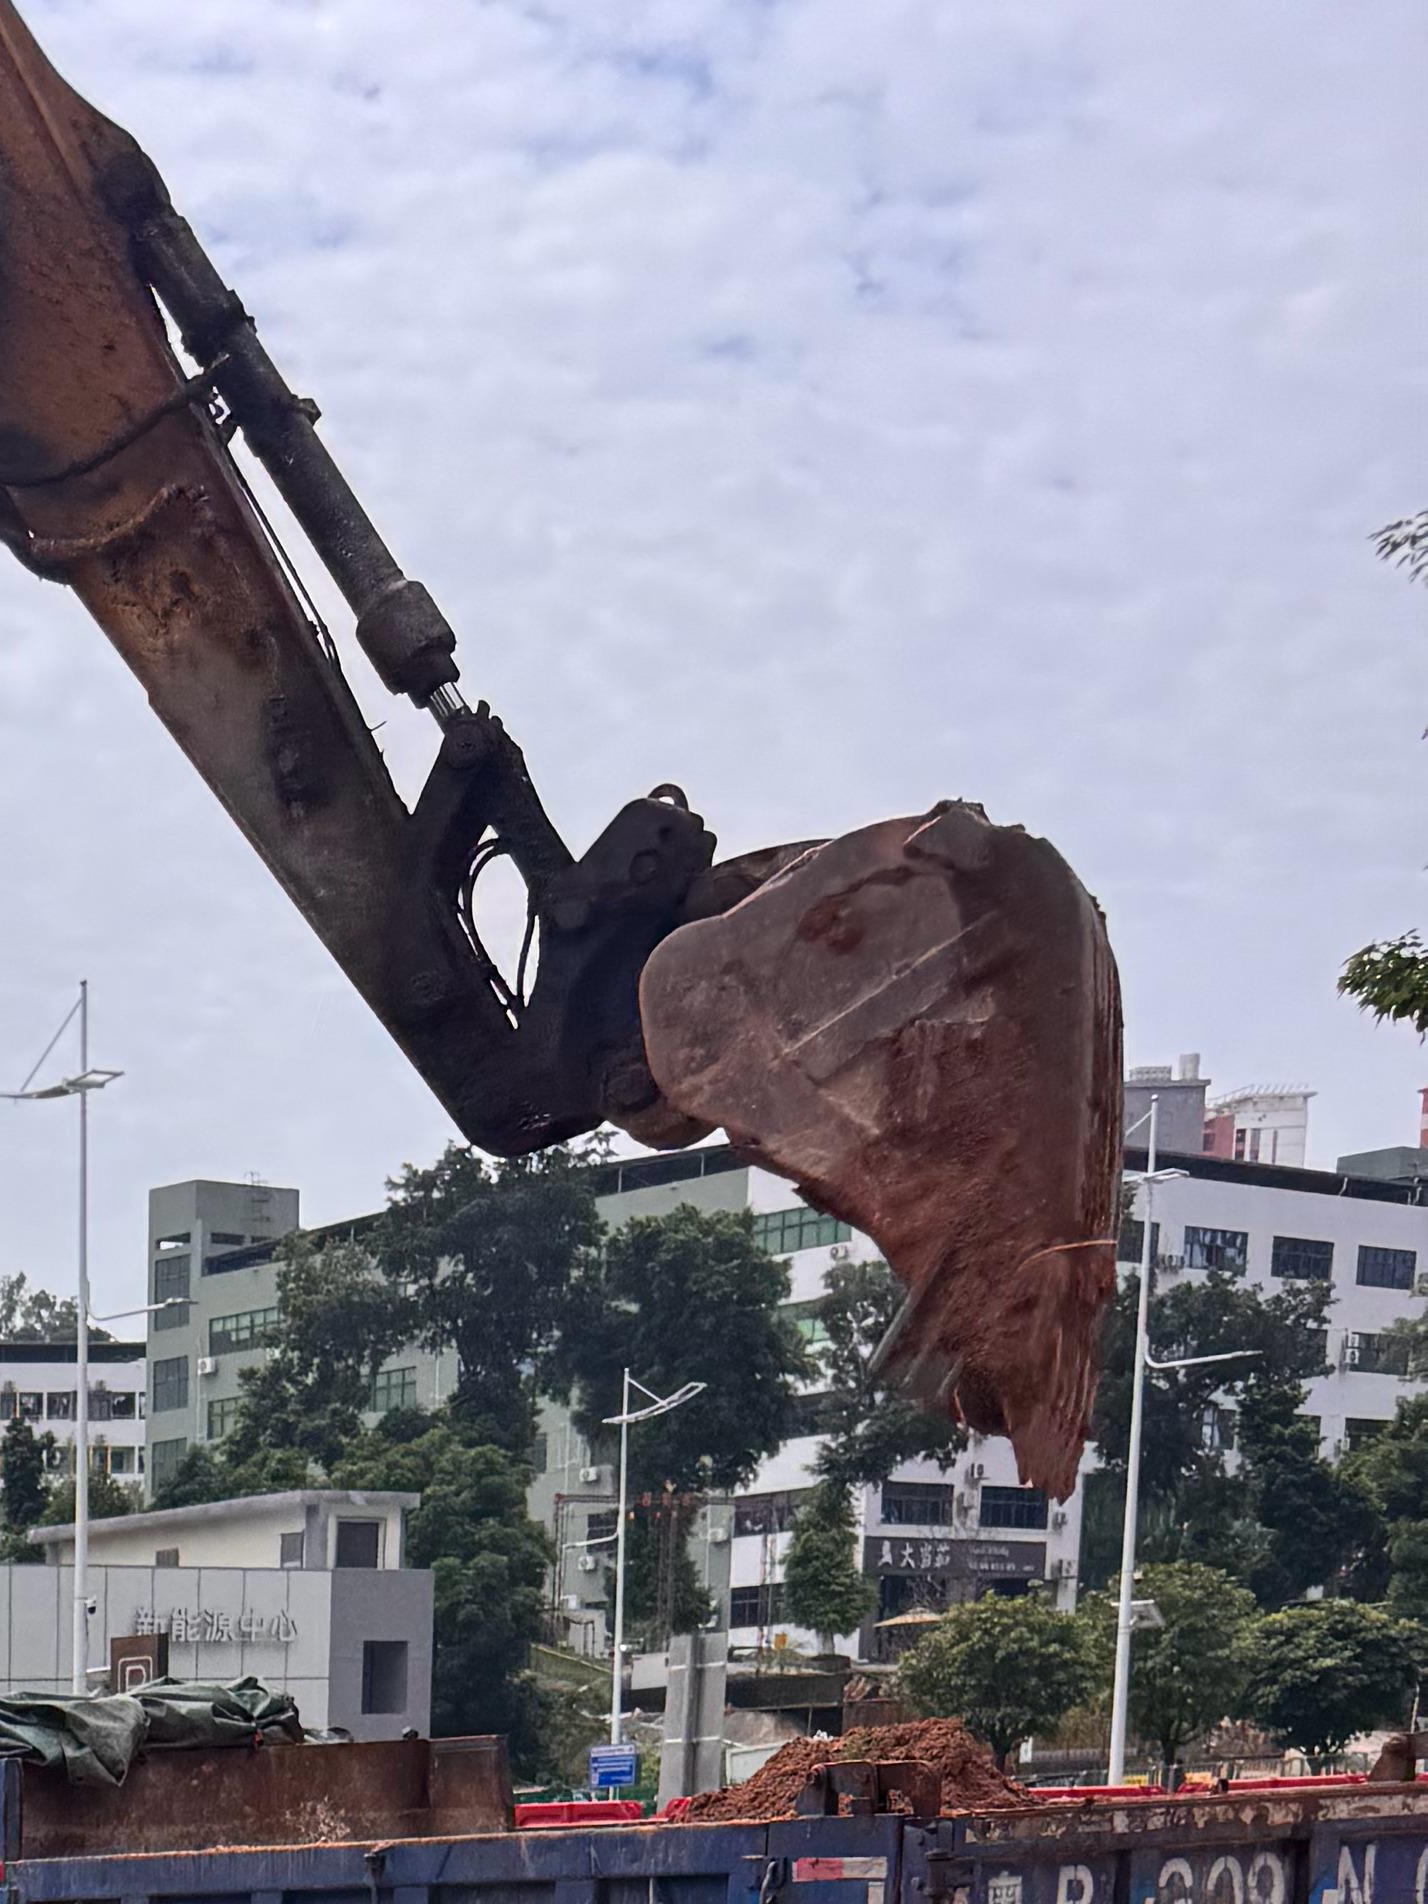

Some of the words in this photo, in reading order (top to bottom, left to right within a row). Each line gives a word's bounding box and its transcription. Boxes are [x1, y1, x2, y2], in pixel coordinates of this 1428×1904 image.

[135, 1607, 297, 1642] 新能源中心
